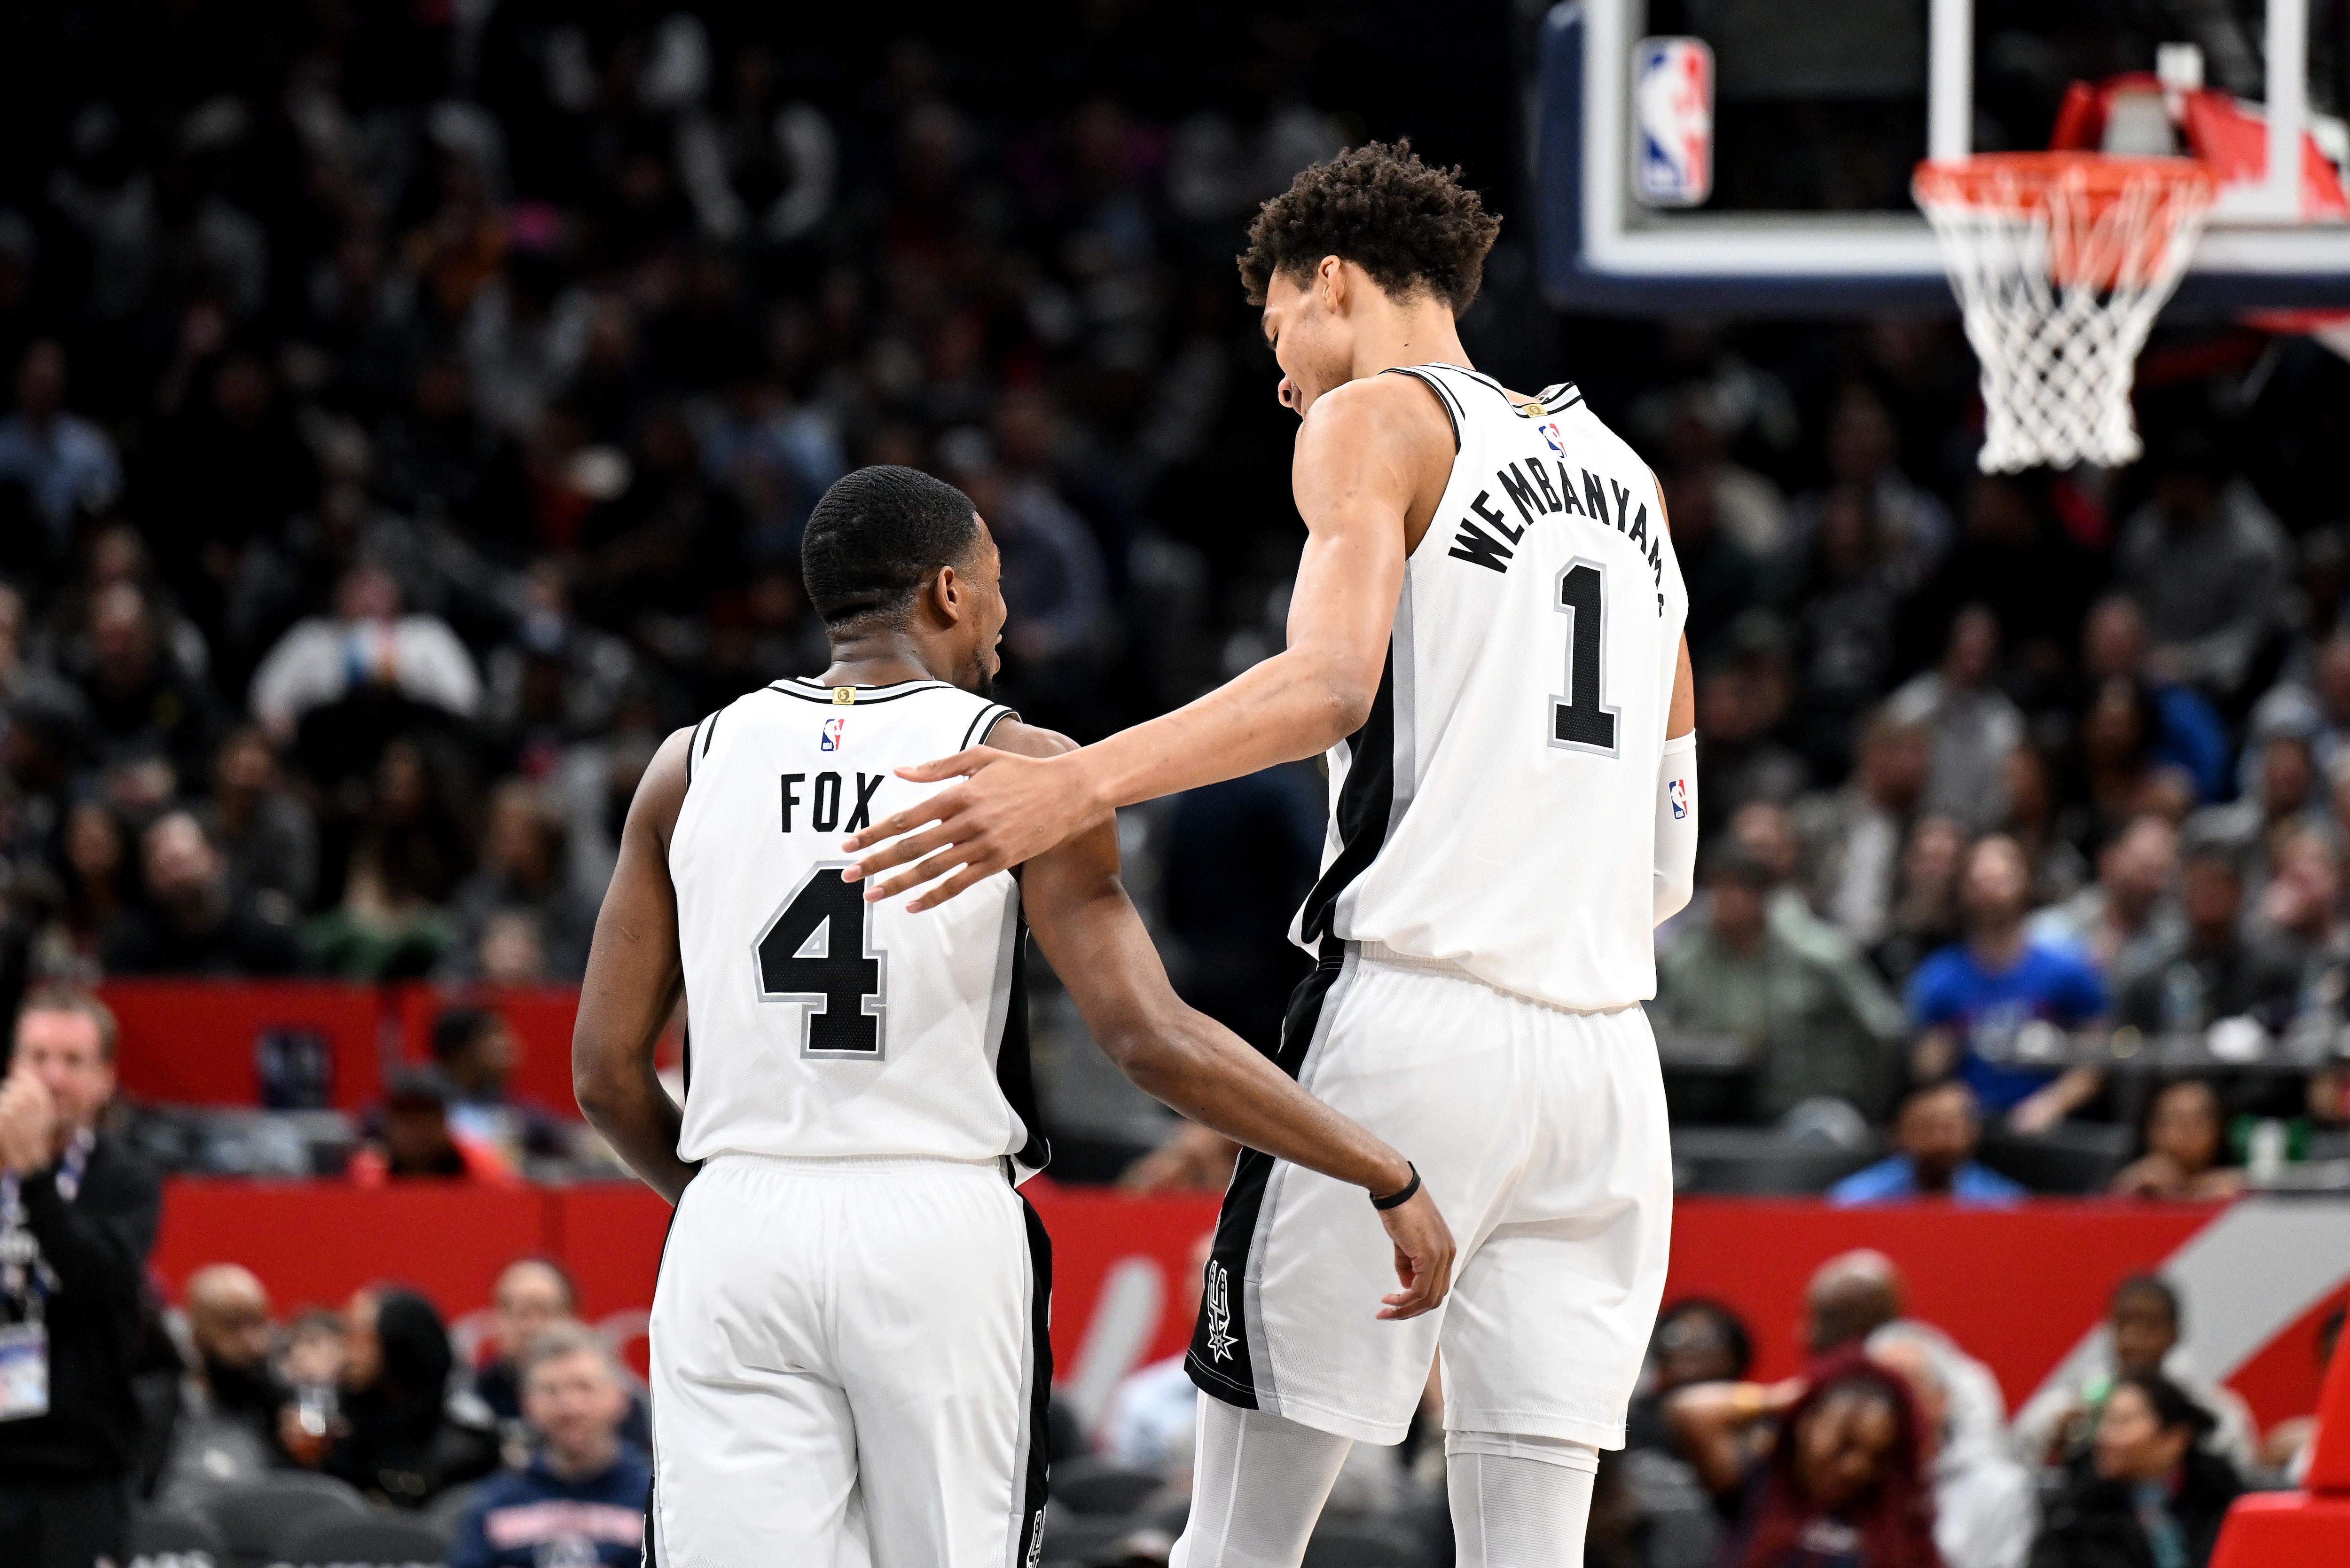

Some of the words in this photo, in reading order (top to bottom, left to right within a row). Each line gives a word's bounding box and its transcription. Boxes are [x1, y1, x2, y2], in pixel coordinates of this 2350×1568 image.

[1547, 555, 1622, 760] 1
[782, 772, 885, 833] FOX
[751, 861, 887, 1060] 4
